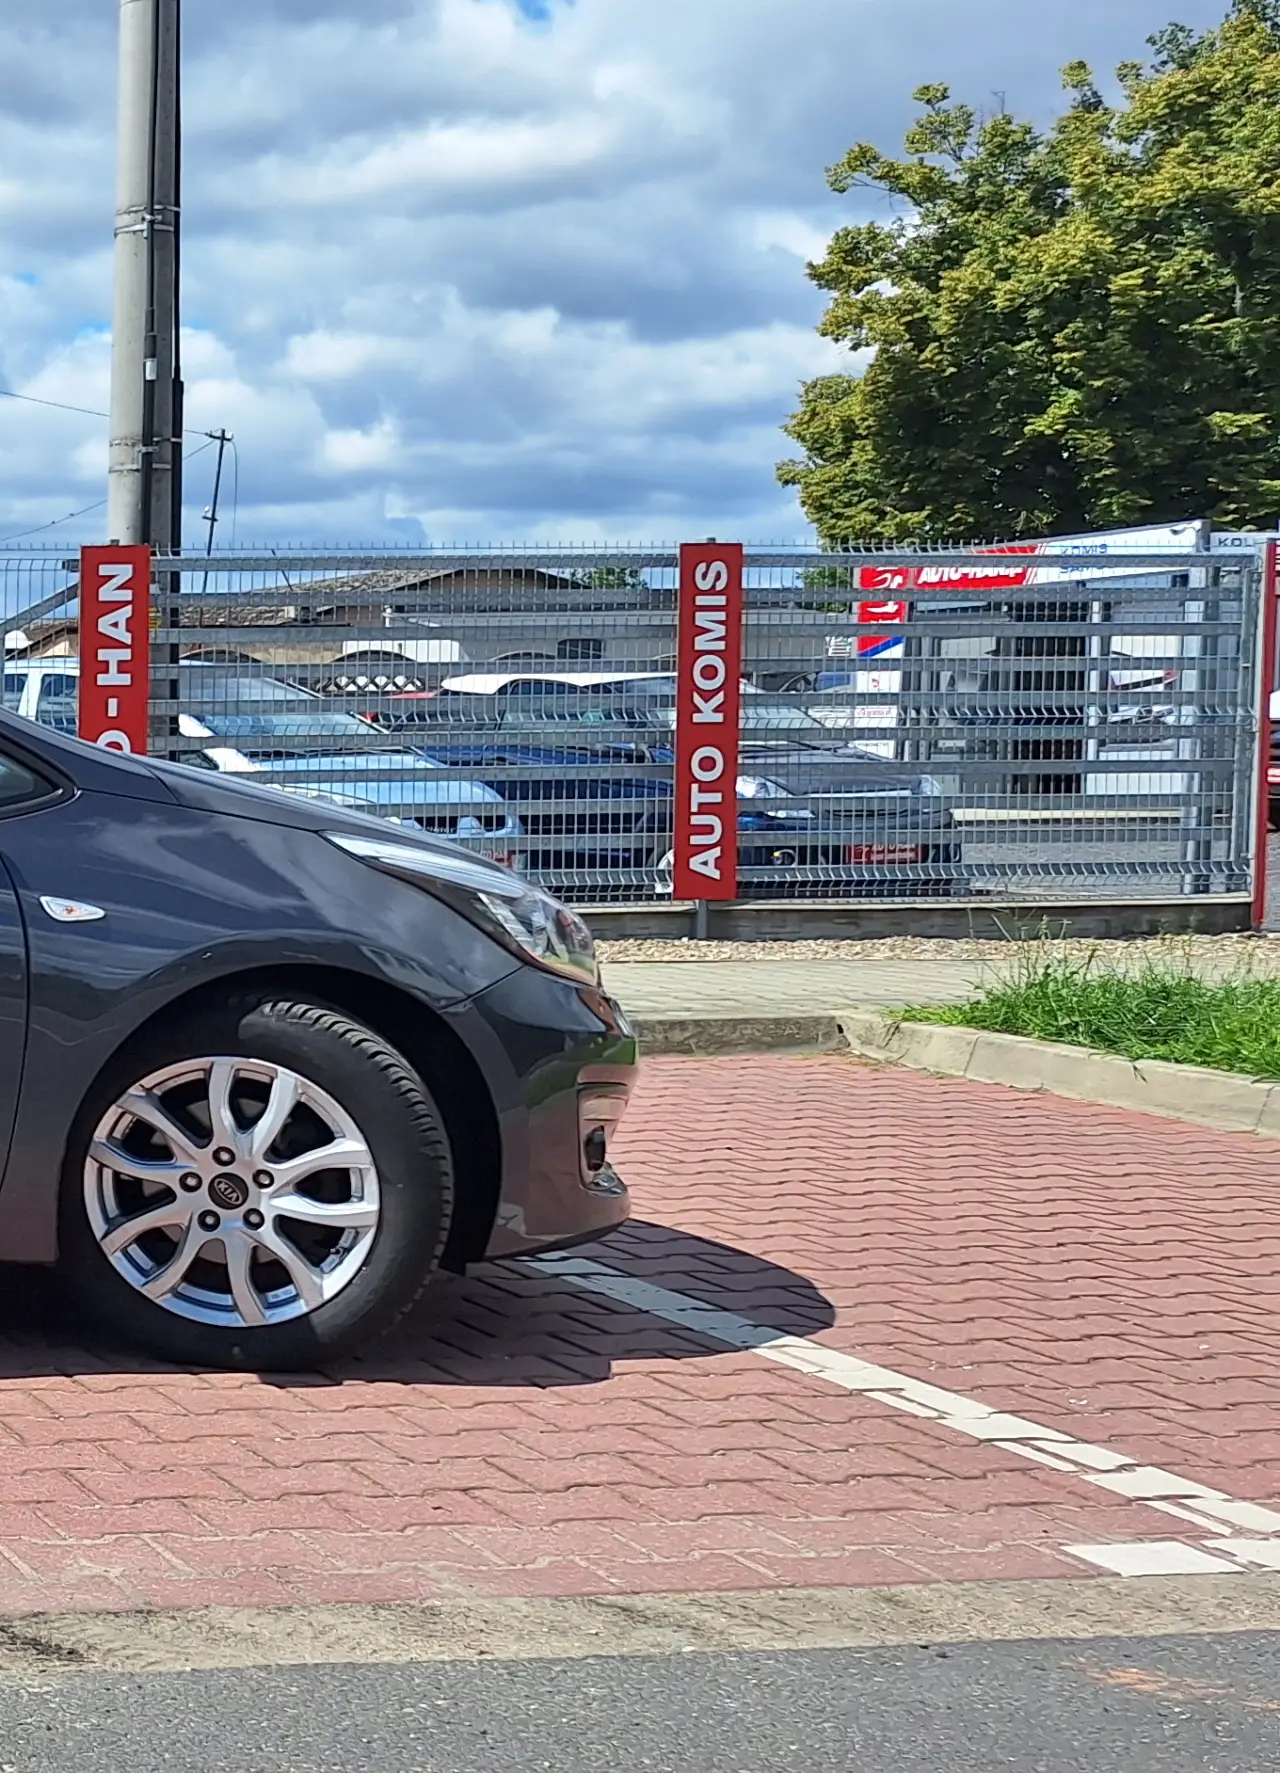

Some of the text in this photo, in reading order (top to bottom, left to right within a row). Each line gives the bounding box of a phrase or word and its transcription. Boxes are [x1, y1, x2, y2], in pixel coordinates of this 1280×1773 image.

[689, 560, 728, 880] AUTO KOMIS
[217, 1180, 240, 1203] KIA
